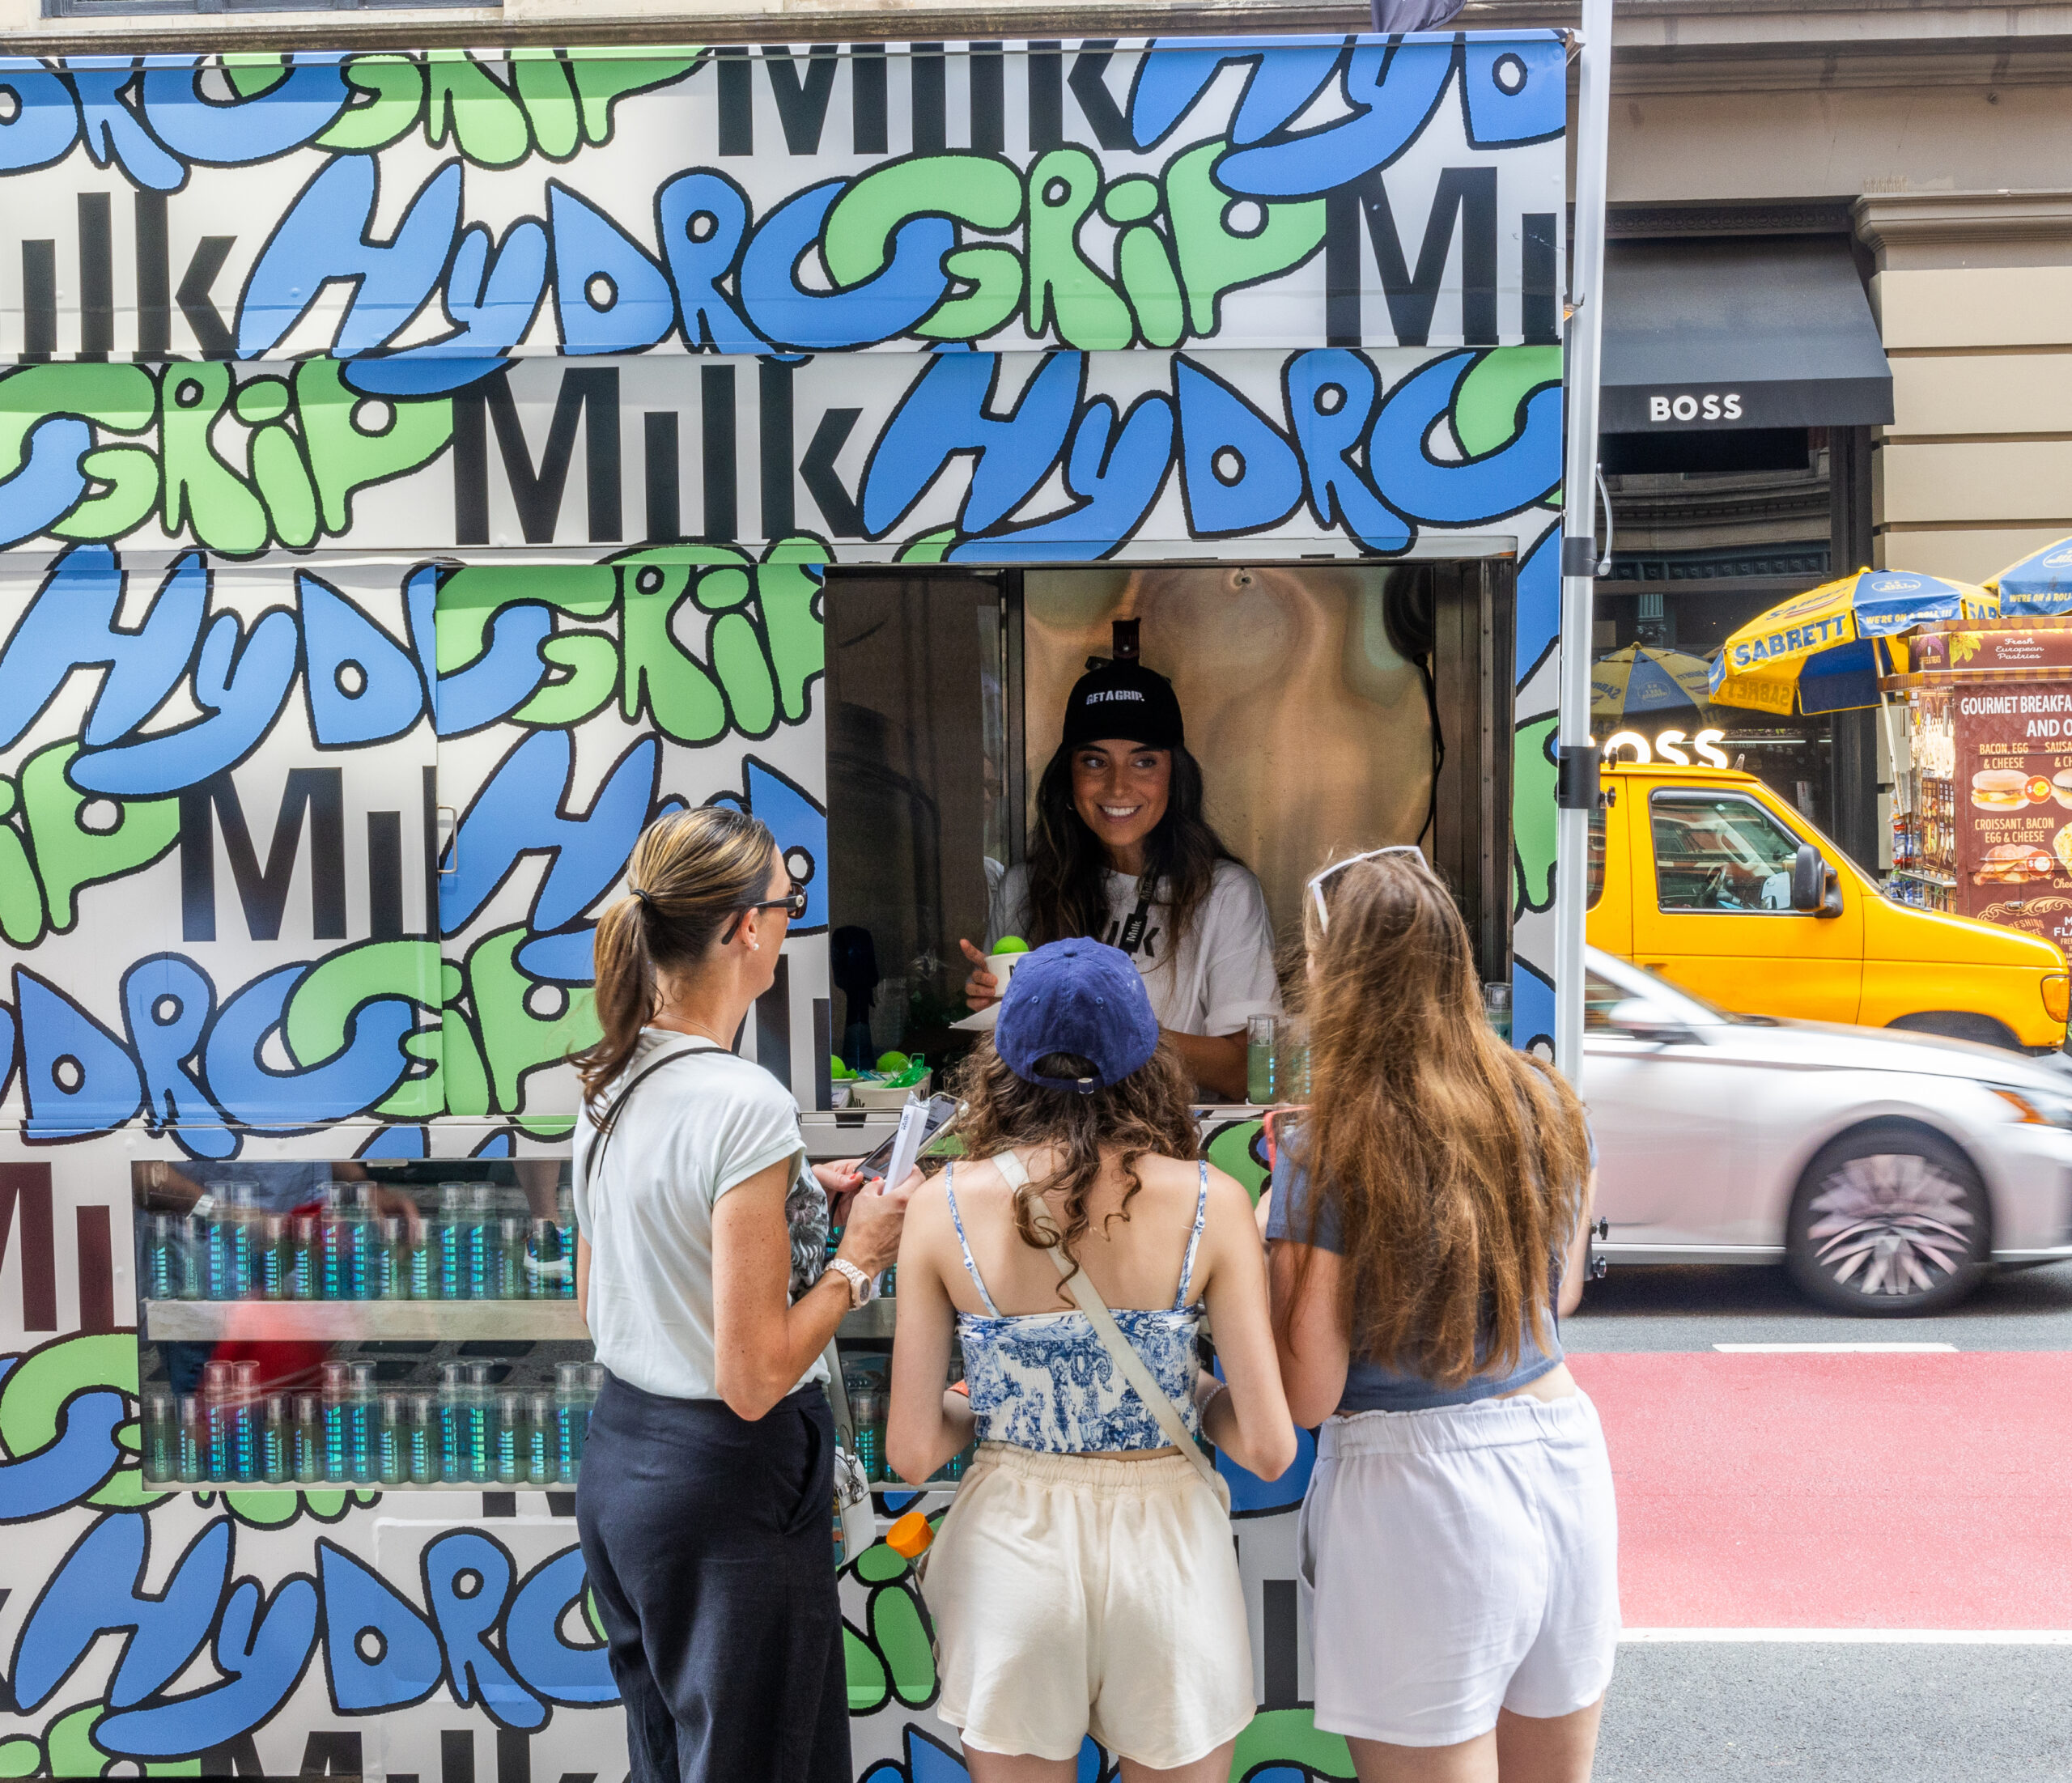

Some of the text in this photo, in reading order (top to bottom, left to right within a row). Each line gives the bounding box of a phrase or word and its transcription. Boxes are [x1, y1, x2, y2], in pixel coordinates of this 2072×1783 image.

[1650, 393, 1743, 422] BOSS
[451, 362, 864, 547] Milk
[2009, 593, 2032, 603] WE'RE
[1866, 614, 1892, 624] WE'RE
[1895, 613, 1907, 622] ON
[1917, 609, 1940, 619] ROLL
[1734, 614, 1847, 667] SABRETT
[2004, 637, 2034, 645] Fresh
[1995, 645, 2044, 654] European
[1086, 691, 1105, 705] GET
[1105, 690, 1114, 701] A
[1960, 696, 2018, 715] GOURMET
[2027, 719, 2060, 737] AND
[1588, 728, 1729, 769] OSS
[2012, 741, 2029, 754] EGG
[1983, 757, 2024, 769] & CHEESE
[2054, 756, 2061, 767] &
[1975, 817, 2054, 831] CROISSANT, BACON
[1985, 830, 2044, 843] EGG & CHEESE
[1125, 919, 1142, 942] Milk
[499, 1431, 514, 1473] Milk
[531, 1432, 544, 1474] Milk
